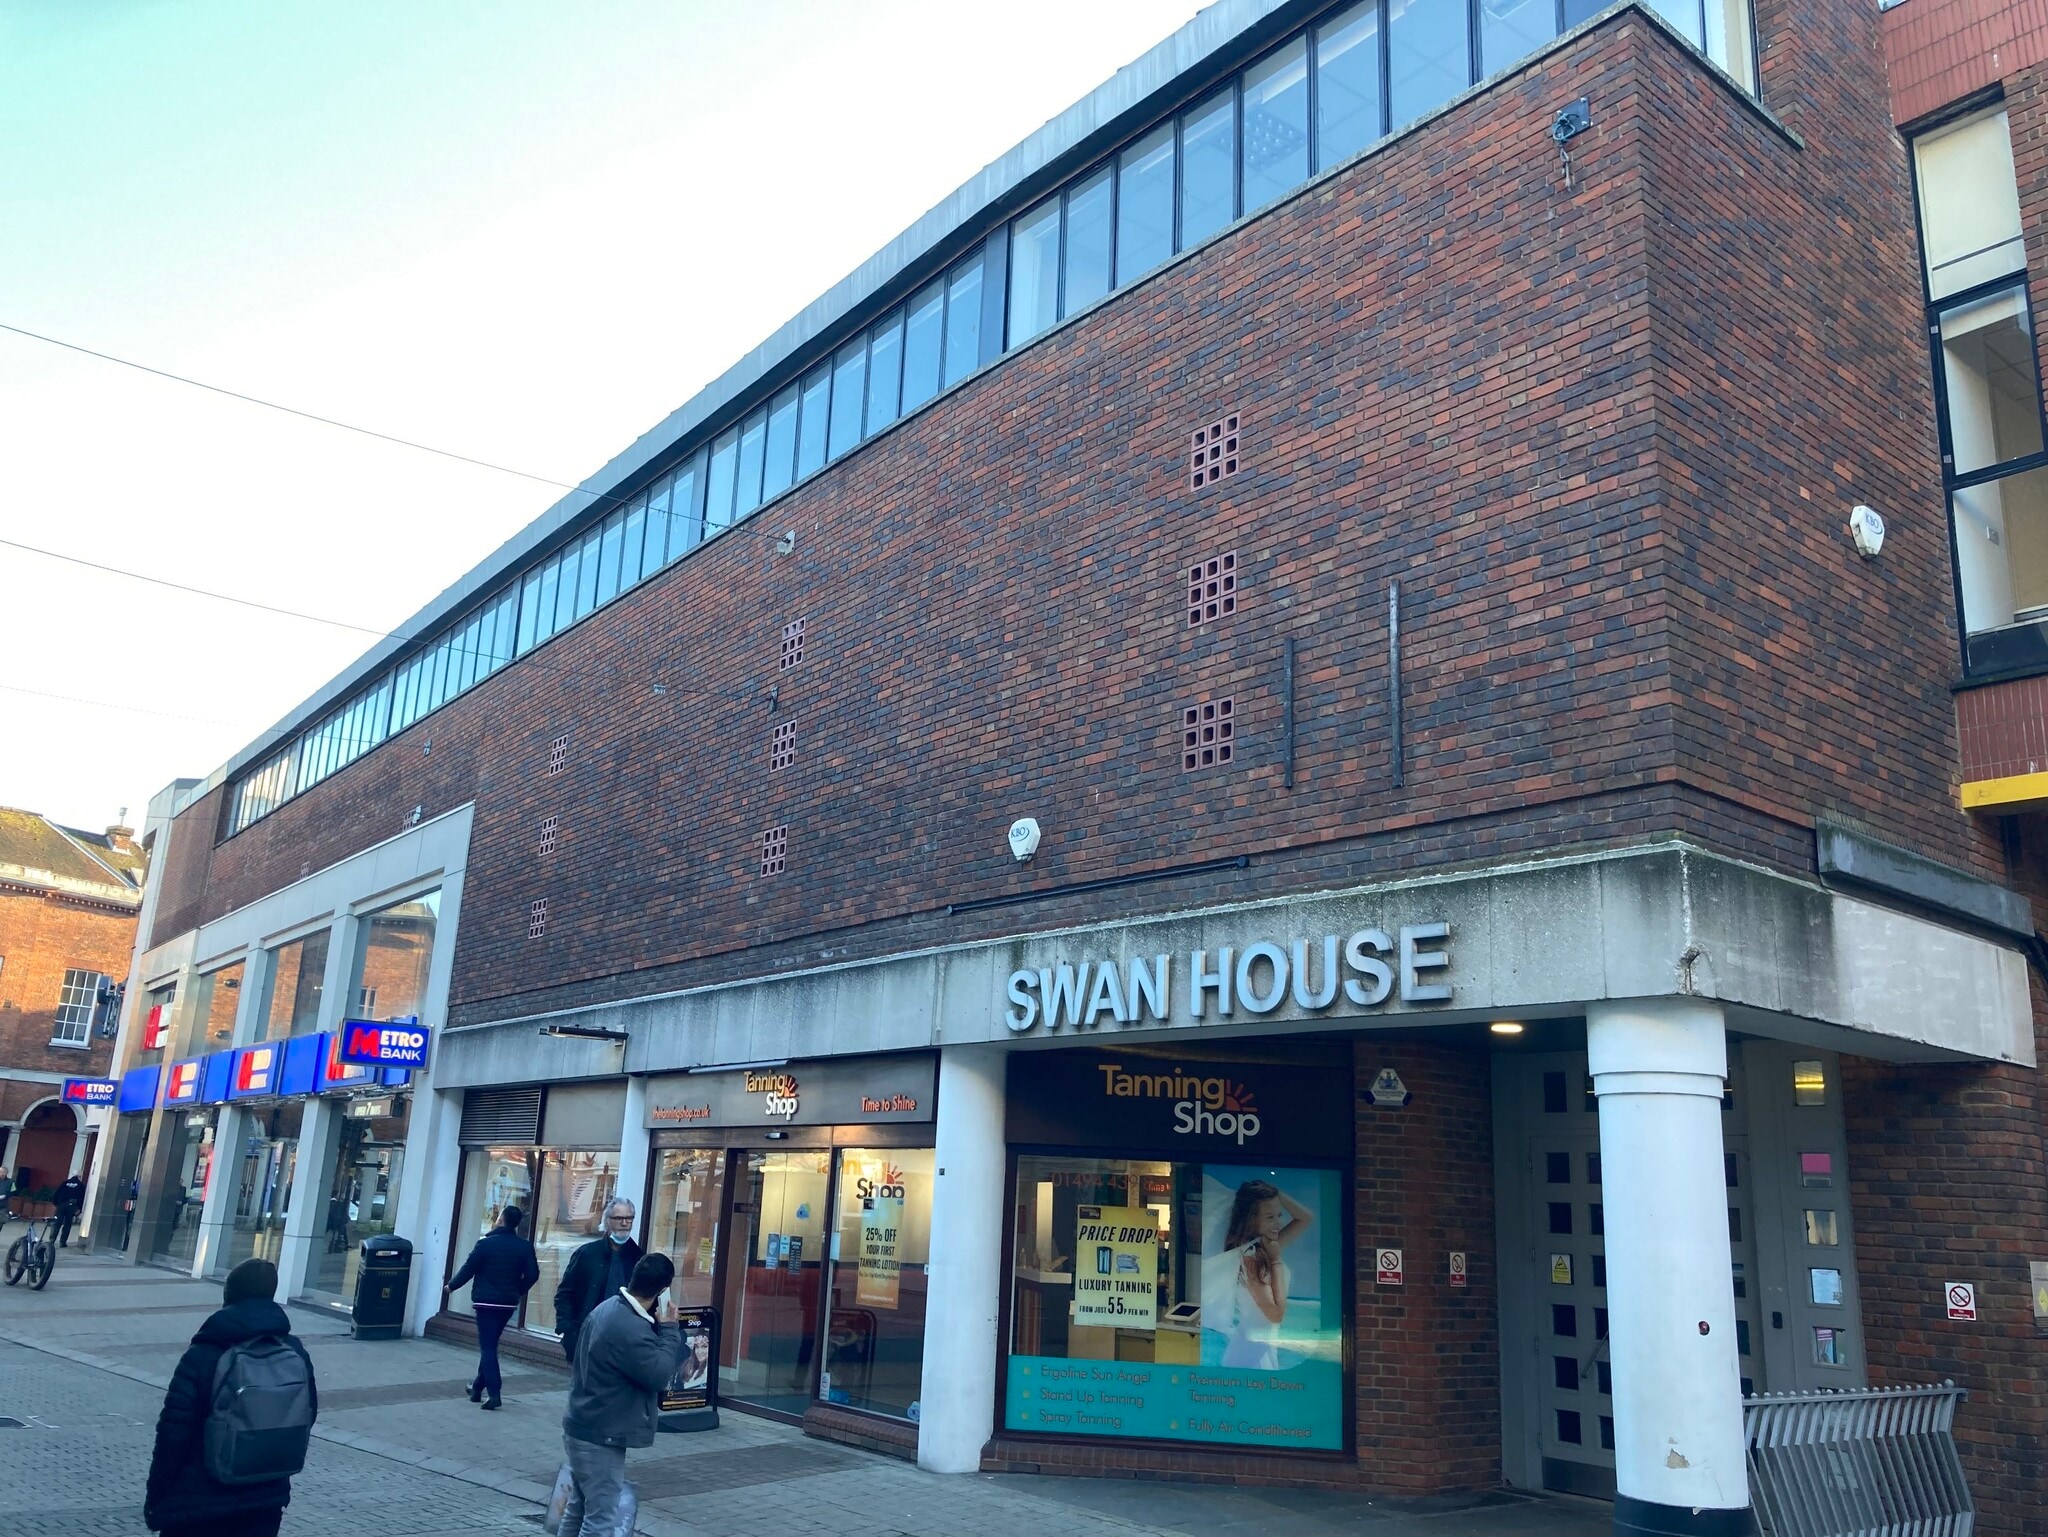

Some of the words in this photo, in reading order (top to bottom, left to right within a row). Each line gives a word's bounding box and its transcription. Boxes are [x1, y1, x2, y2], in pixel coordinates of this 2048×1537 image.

[1005, 953, 1171, 1032] SWAN
[1190, 921, 1454, 1017] HOUSE
[348, 1026, 424, 1057] METRO
[380, 1047, 421, 1061] BANK
[66, 1082, 115, 1099] METRO
[744, 1069, 787, 1097] Tanning
[1098, 1064, 1226, 1111] Tanning
[86, 1093, 112, 1101] BANK
[765, 1092, 797, 1121] Shop
[862, 1097, 880, 1112] Time
[881, 1099, 891, 1112] to
[892, 1094, 917, 1112] Shine
[1173, 1101, 1261, 1146] Shop
[865, 1227, 882, 1242] 25%
[884, 1228, 897, 1243] OFF
[1078, 1225, 1117, 1242] PRICE
[1118, 1227, 1159, 1244] DROP!
[865, 1244, 880, 1256] YOUR
[880, 1245, 895, 1257] FIRST
[859, 1257, 881, 1270] TANNING
[881, 1259, 900, 1271] LOTION
[1078, 1278, 1112, 1292] LUXURY
[1114, 1280, 1152, 1294] TANNING
[1079, 1305, 1093, 1313] FROM
[688, 1320, 701, 1328] Shop
[1117, 1370, 1151, 1385] Angel
[1188, 1372, 1241, 1388] Premium
[1245, 1376, 1266, 1390] Lay
[1269, 1377, 1305, 1391] Down
[1041, 1387, 1073, 1402] Stand
[1077, 1389, 1095, 1405] Up
[1099, 1391, 1144, 1408] Tanning
[1188, 1389, 1236, 1408] Tanning
[1040, 1409, 1071, 1425] Spray
[1076, 1410, 1122, 1429] Tanning
[1188, 1418, 1214, 1434] Fully
[1217, 1421, 1234, 1434] Air
[1237, 1421, 1312, 1438] Conditioned
